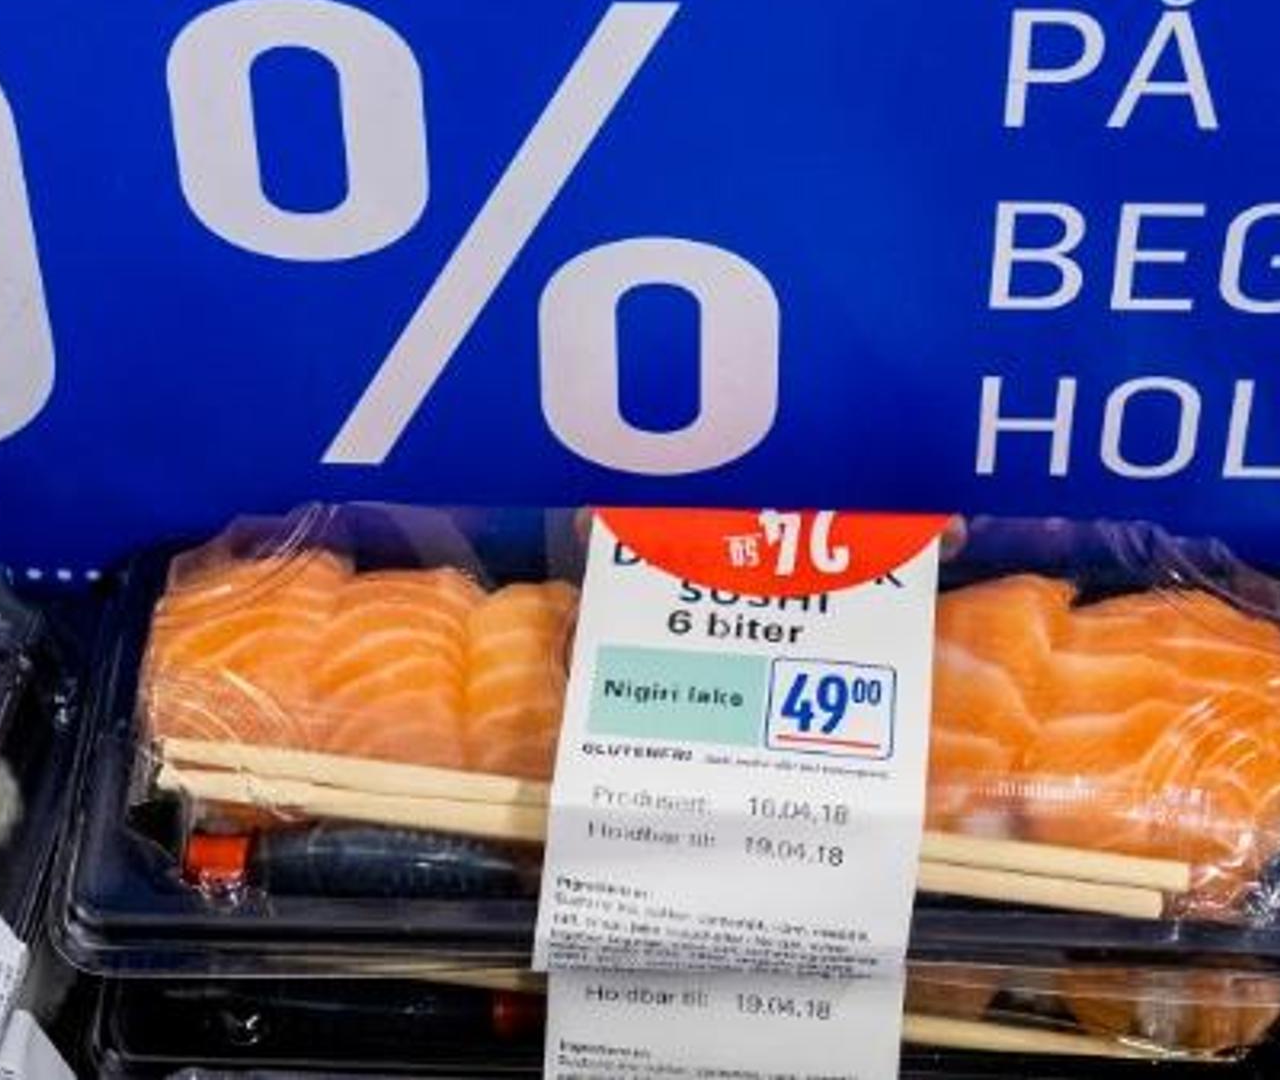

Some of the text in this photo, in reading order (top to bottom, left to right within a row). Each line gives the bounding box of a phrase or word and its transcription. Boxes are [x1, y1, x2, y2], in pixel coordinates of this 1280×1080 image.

[667, 609, 805, 644] 6 biter
[603, 678, 679, 705] Nigiri
